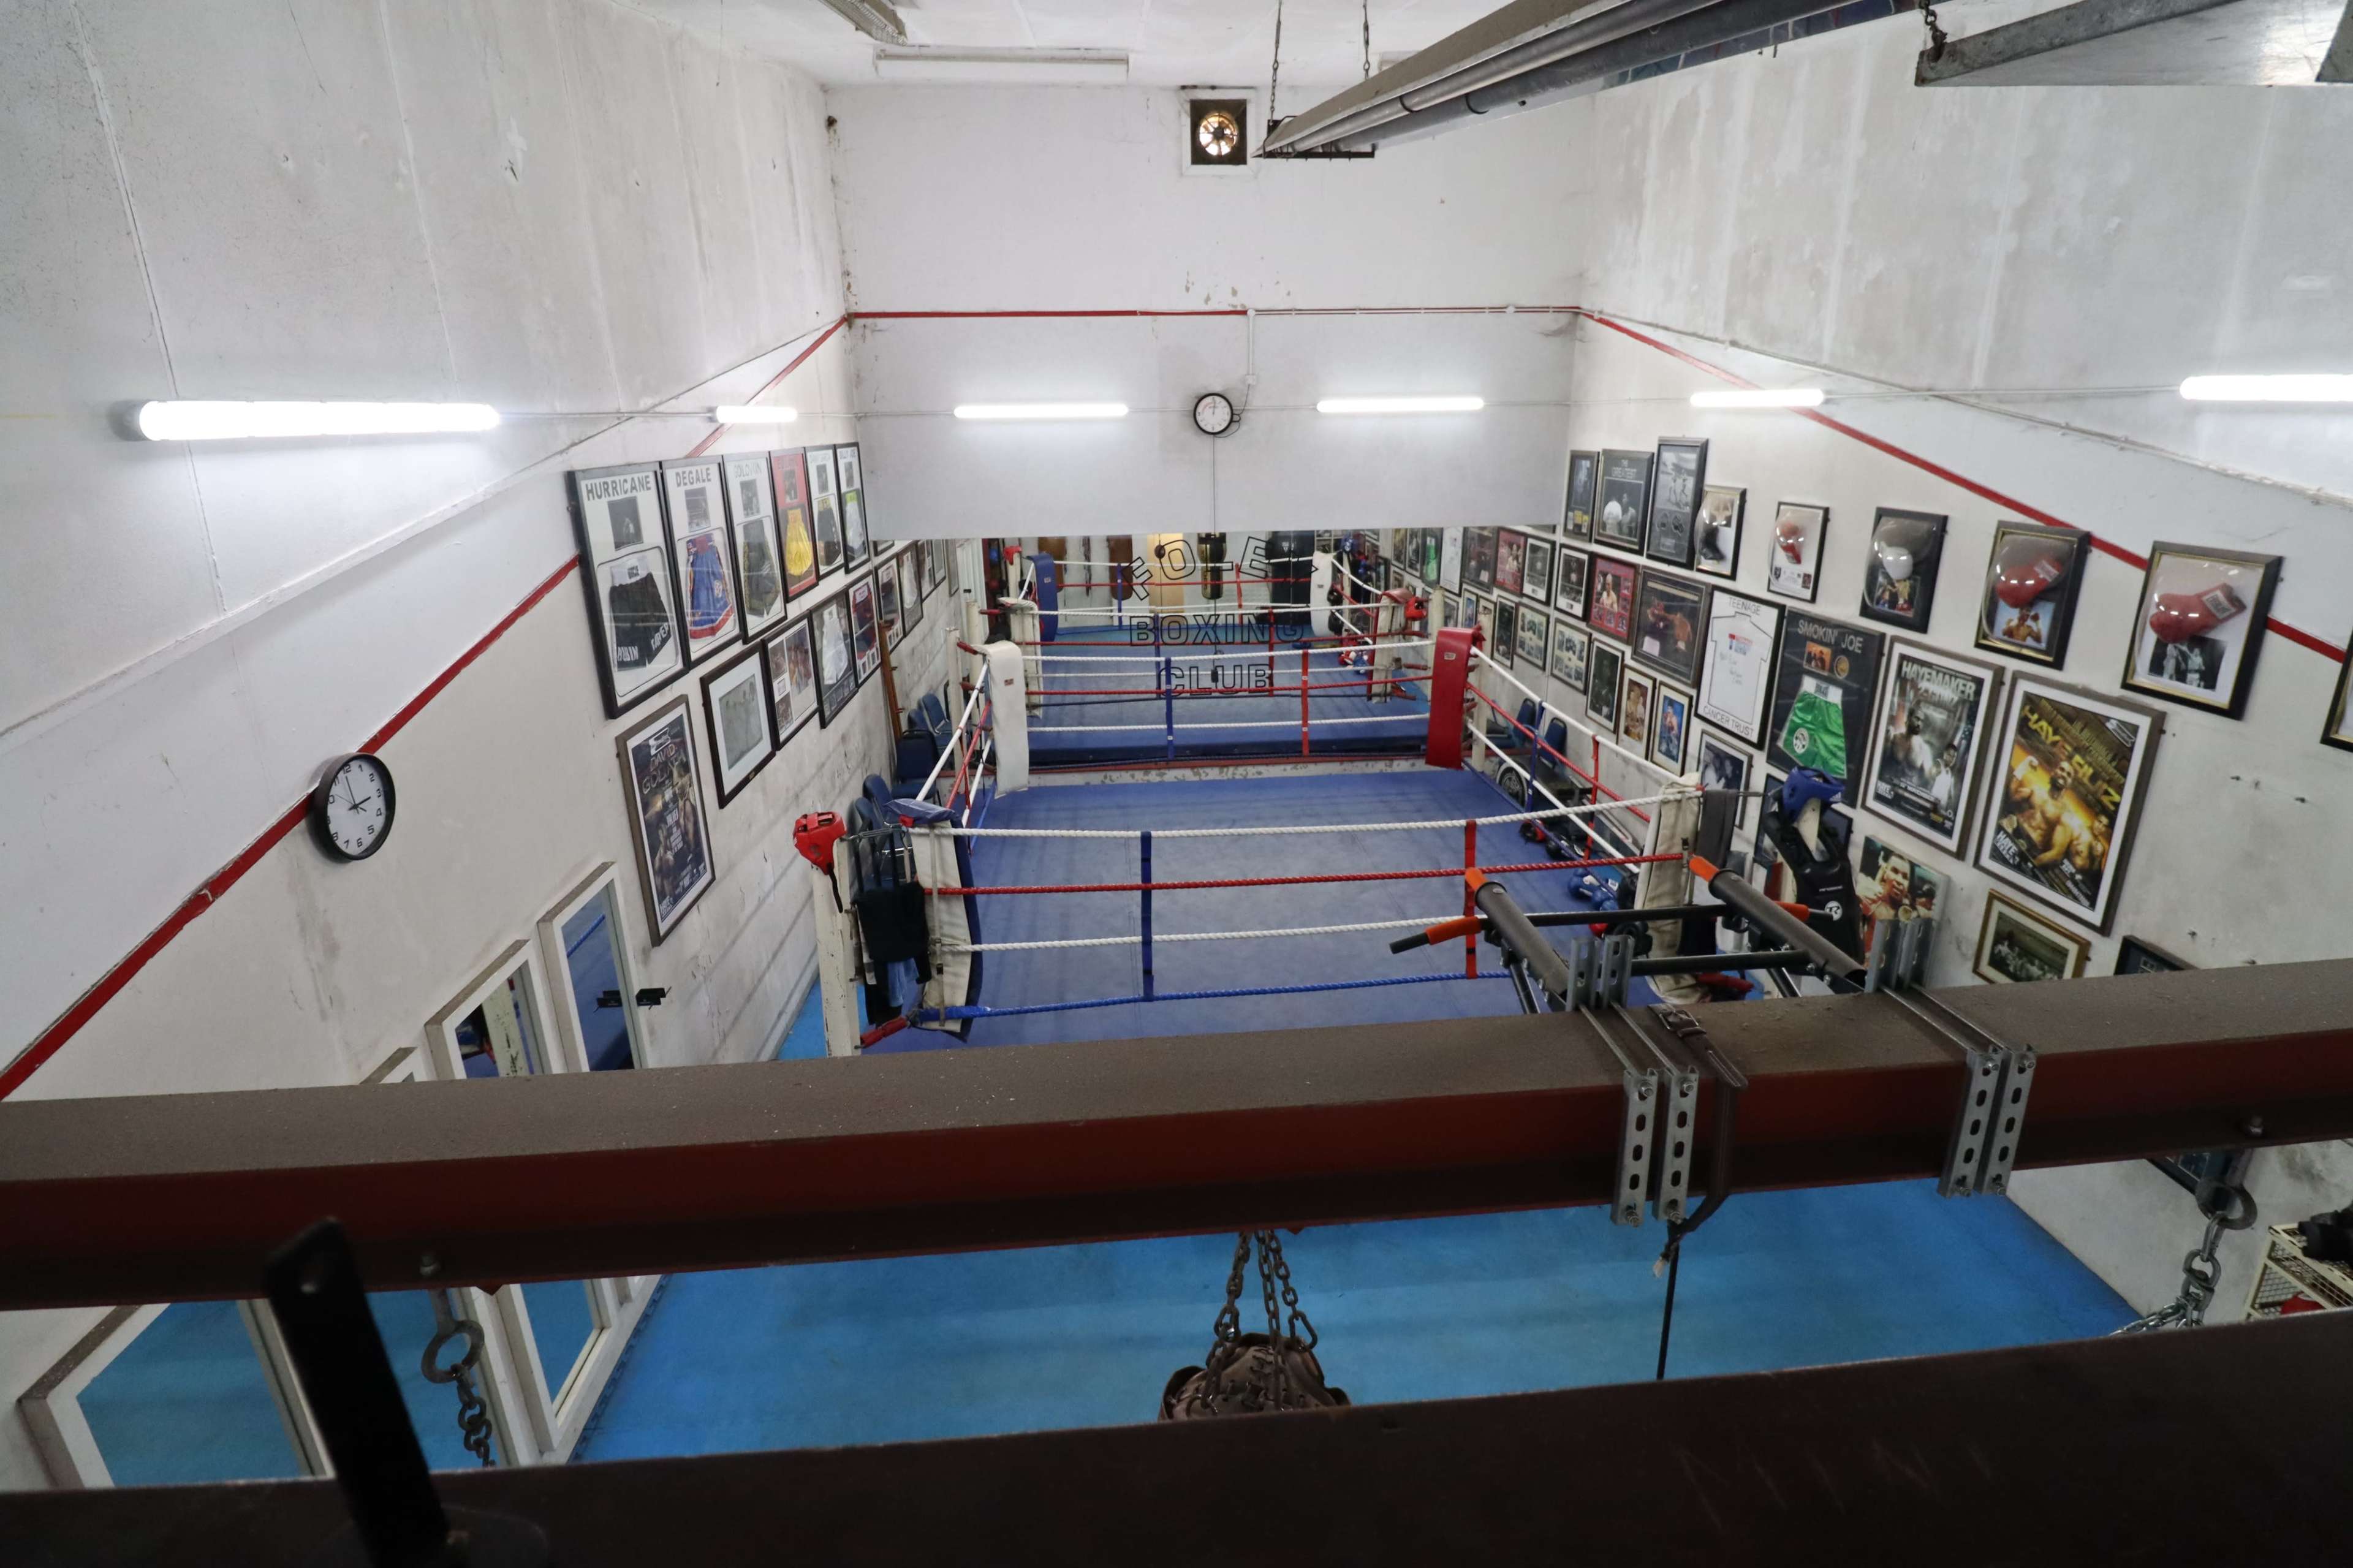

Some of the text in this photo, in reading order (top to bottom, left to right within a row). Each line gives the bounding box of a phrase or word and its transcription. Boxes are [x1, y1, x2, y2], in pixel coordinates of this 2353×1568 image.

[675, 468, 711, 488] DEGALE
[585, 475, 652, 501] HURRICANE
[1729, 596, 1761, 615] TEENAGE
[1129, 613, 1304, 646] BOXING
[1841, 634, 1863, 654] JOE
[1159, 664, 1273, 697] CLUB
[1901, 660, 1976, 702] HAYEMAKER
[1703, 705, 1754, 738] CANCER TRUST
[343, 764, 351, 775] 12
[369, 773, 375, 782] 2
[376, 807, 382, 817] 4
[367, 824, 374, 835] 5
[344, 839, 349, 849] 7
[357, 838, 363, 848] 6
